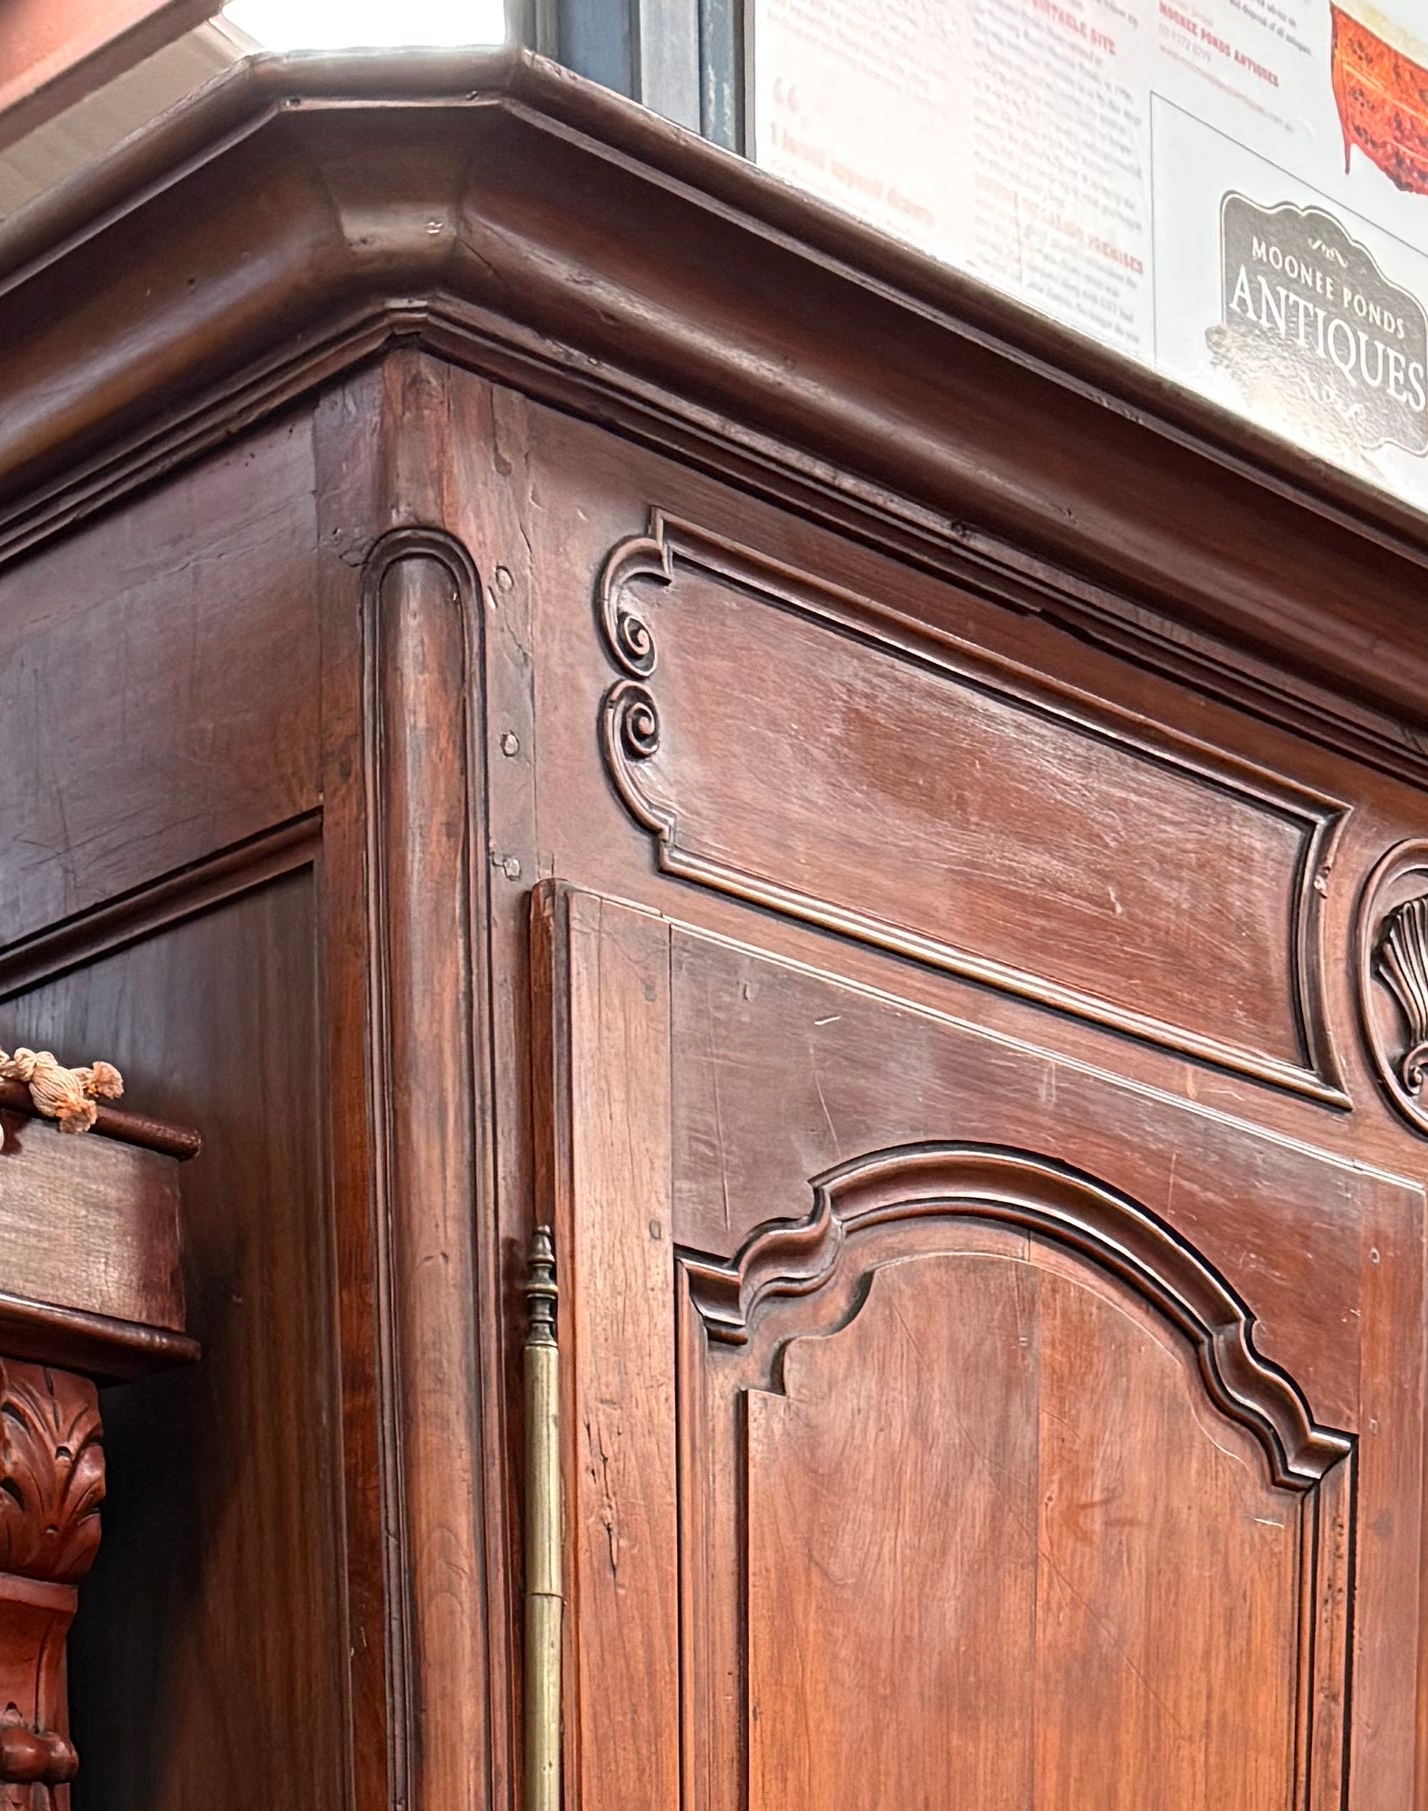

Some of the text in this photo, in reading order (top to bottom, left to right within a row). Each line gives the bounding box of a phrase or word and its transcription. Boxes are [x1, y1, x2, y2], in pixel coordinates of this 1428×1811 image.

[1229, 264, 1426, 412] ANTIQUES
[1252, 236, 1406, 340] MOONEE PONDS
